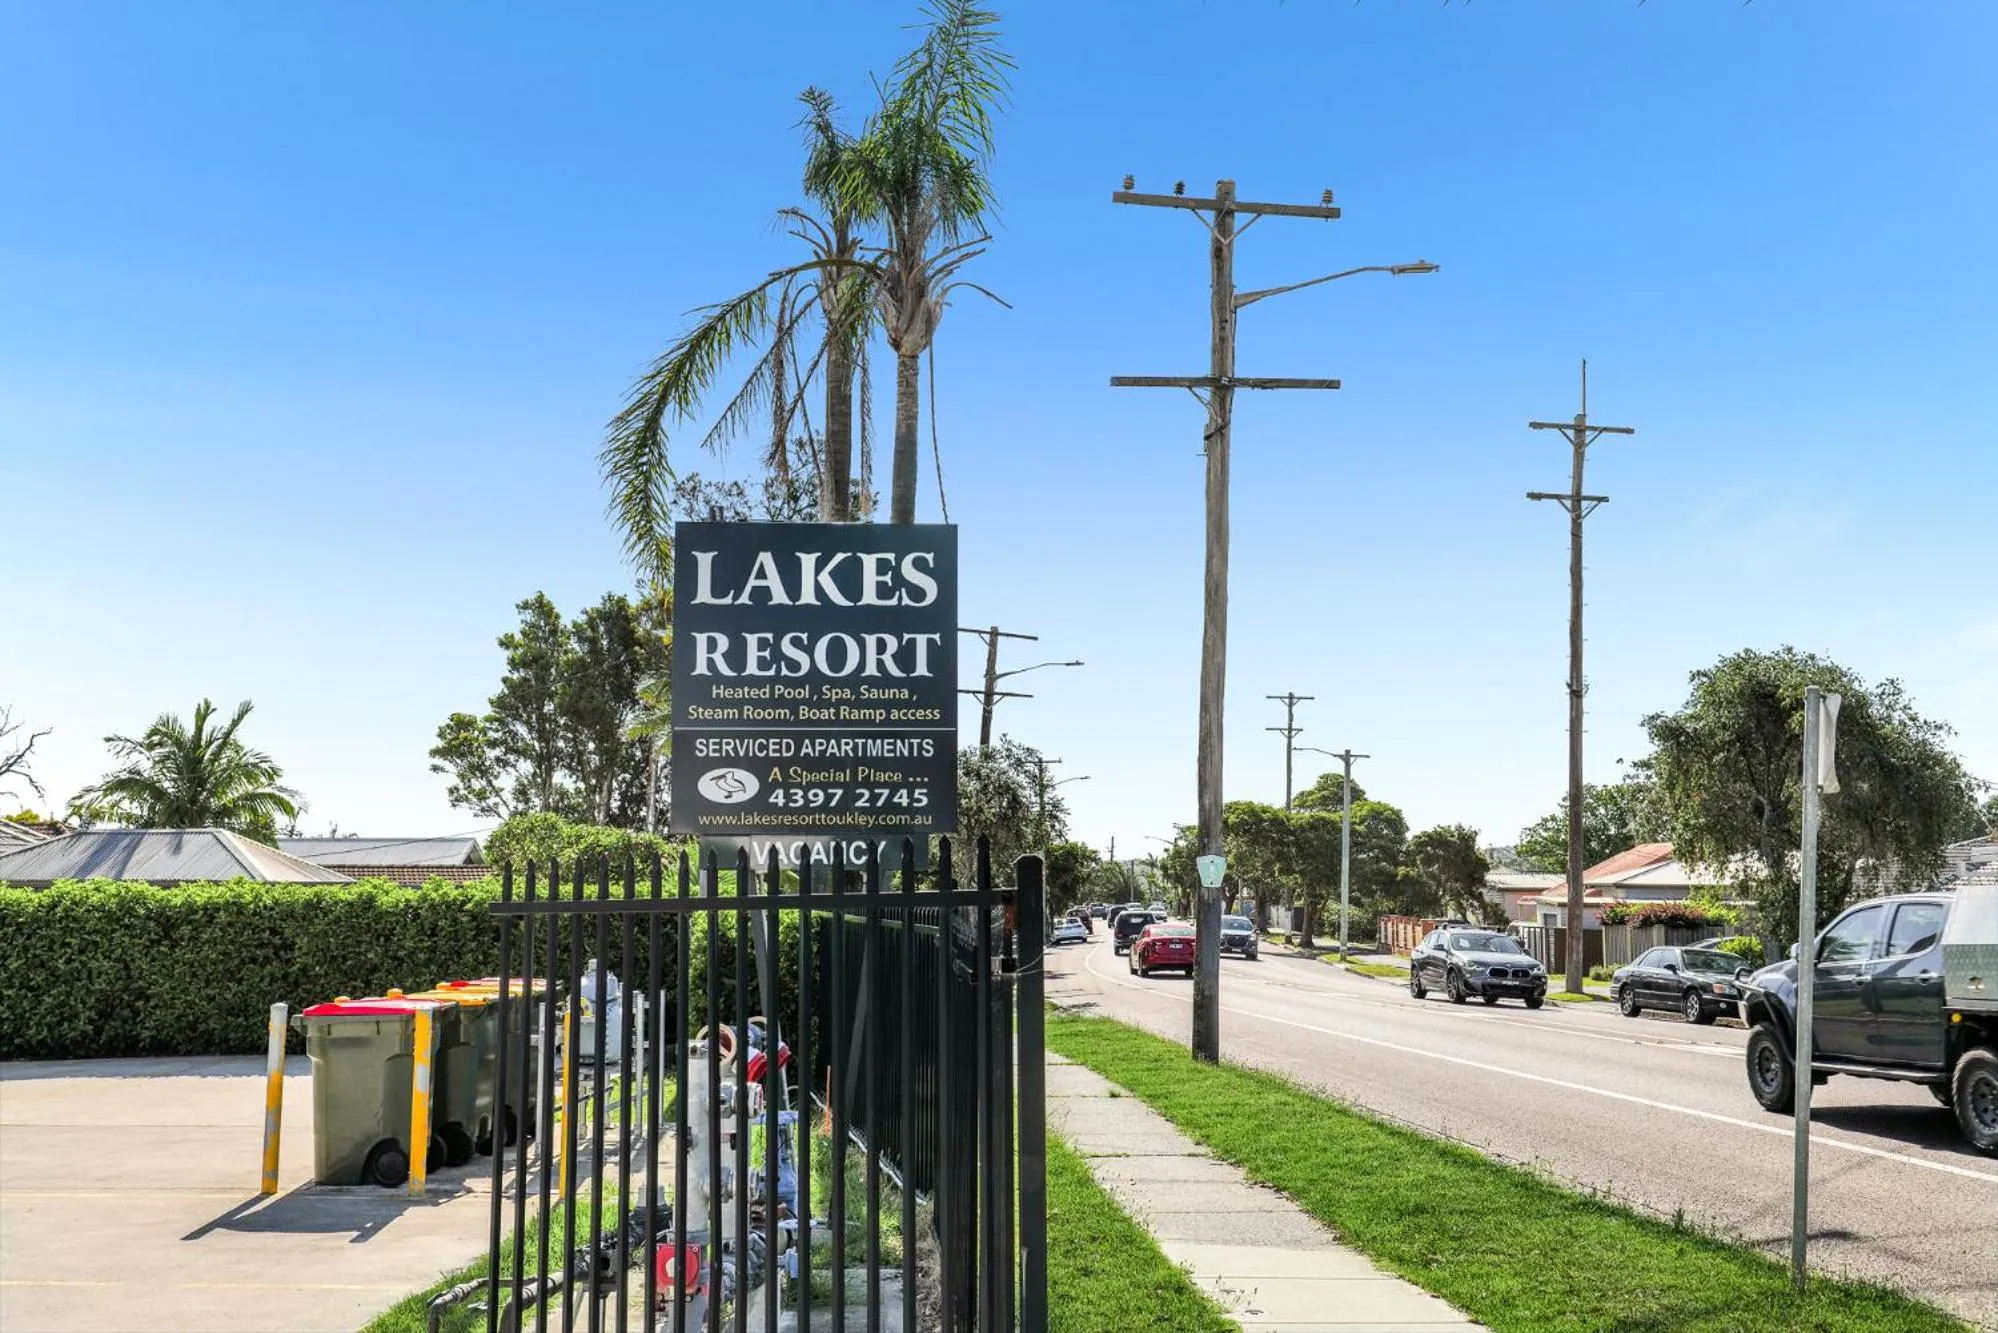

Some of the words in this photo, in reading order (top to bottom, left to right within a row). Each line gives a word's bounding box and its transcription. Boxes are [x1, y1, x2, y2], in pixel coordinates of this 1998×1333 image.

[690, 551, 939, 607] LAKES
[690, 632, 942, 678] RESORT
[712, 684, 770, 699] Heated
[774, 684, 809, 699] Pool
[821, 685, 856, 703] Spa,
[860, 685, 909, 699] Sauna
[688, 705, 739, 720] Steam
[743, 705, 795, 722] Room,
[799, 705, 836, 720] Boat
[840, 705, 886, 723] Ramp
[890, 708, 941, 720] access
[695, 738, 795, 757] SERVICED
[800, 738, 934, 757] APARTMENTS
[768, 766, 783, 783] A
[788, 766, 850, 786] Special
[858, 766, 902, 783] Place
[768, 788, 844, 808] 4397
[854, 788, 929, 808] 2745
[698, 811, 932, 828] www.lakesresorttoukley.com.au
